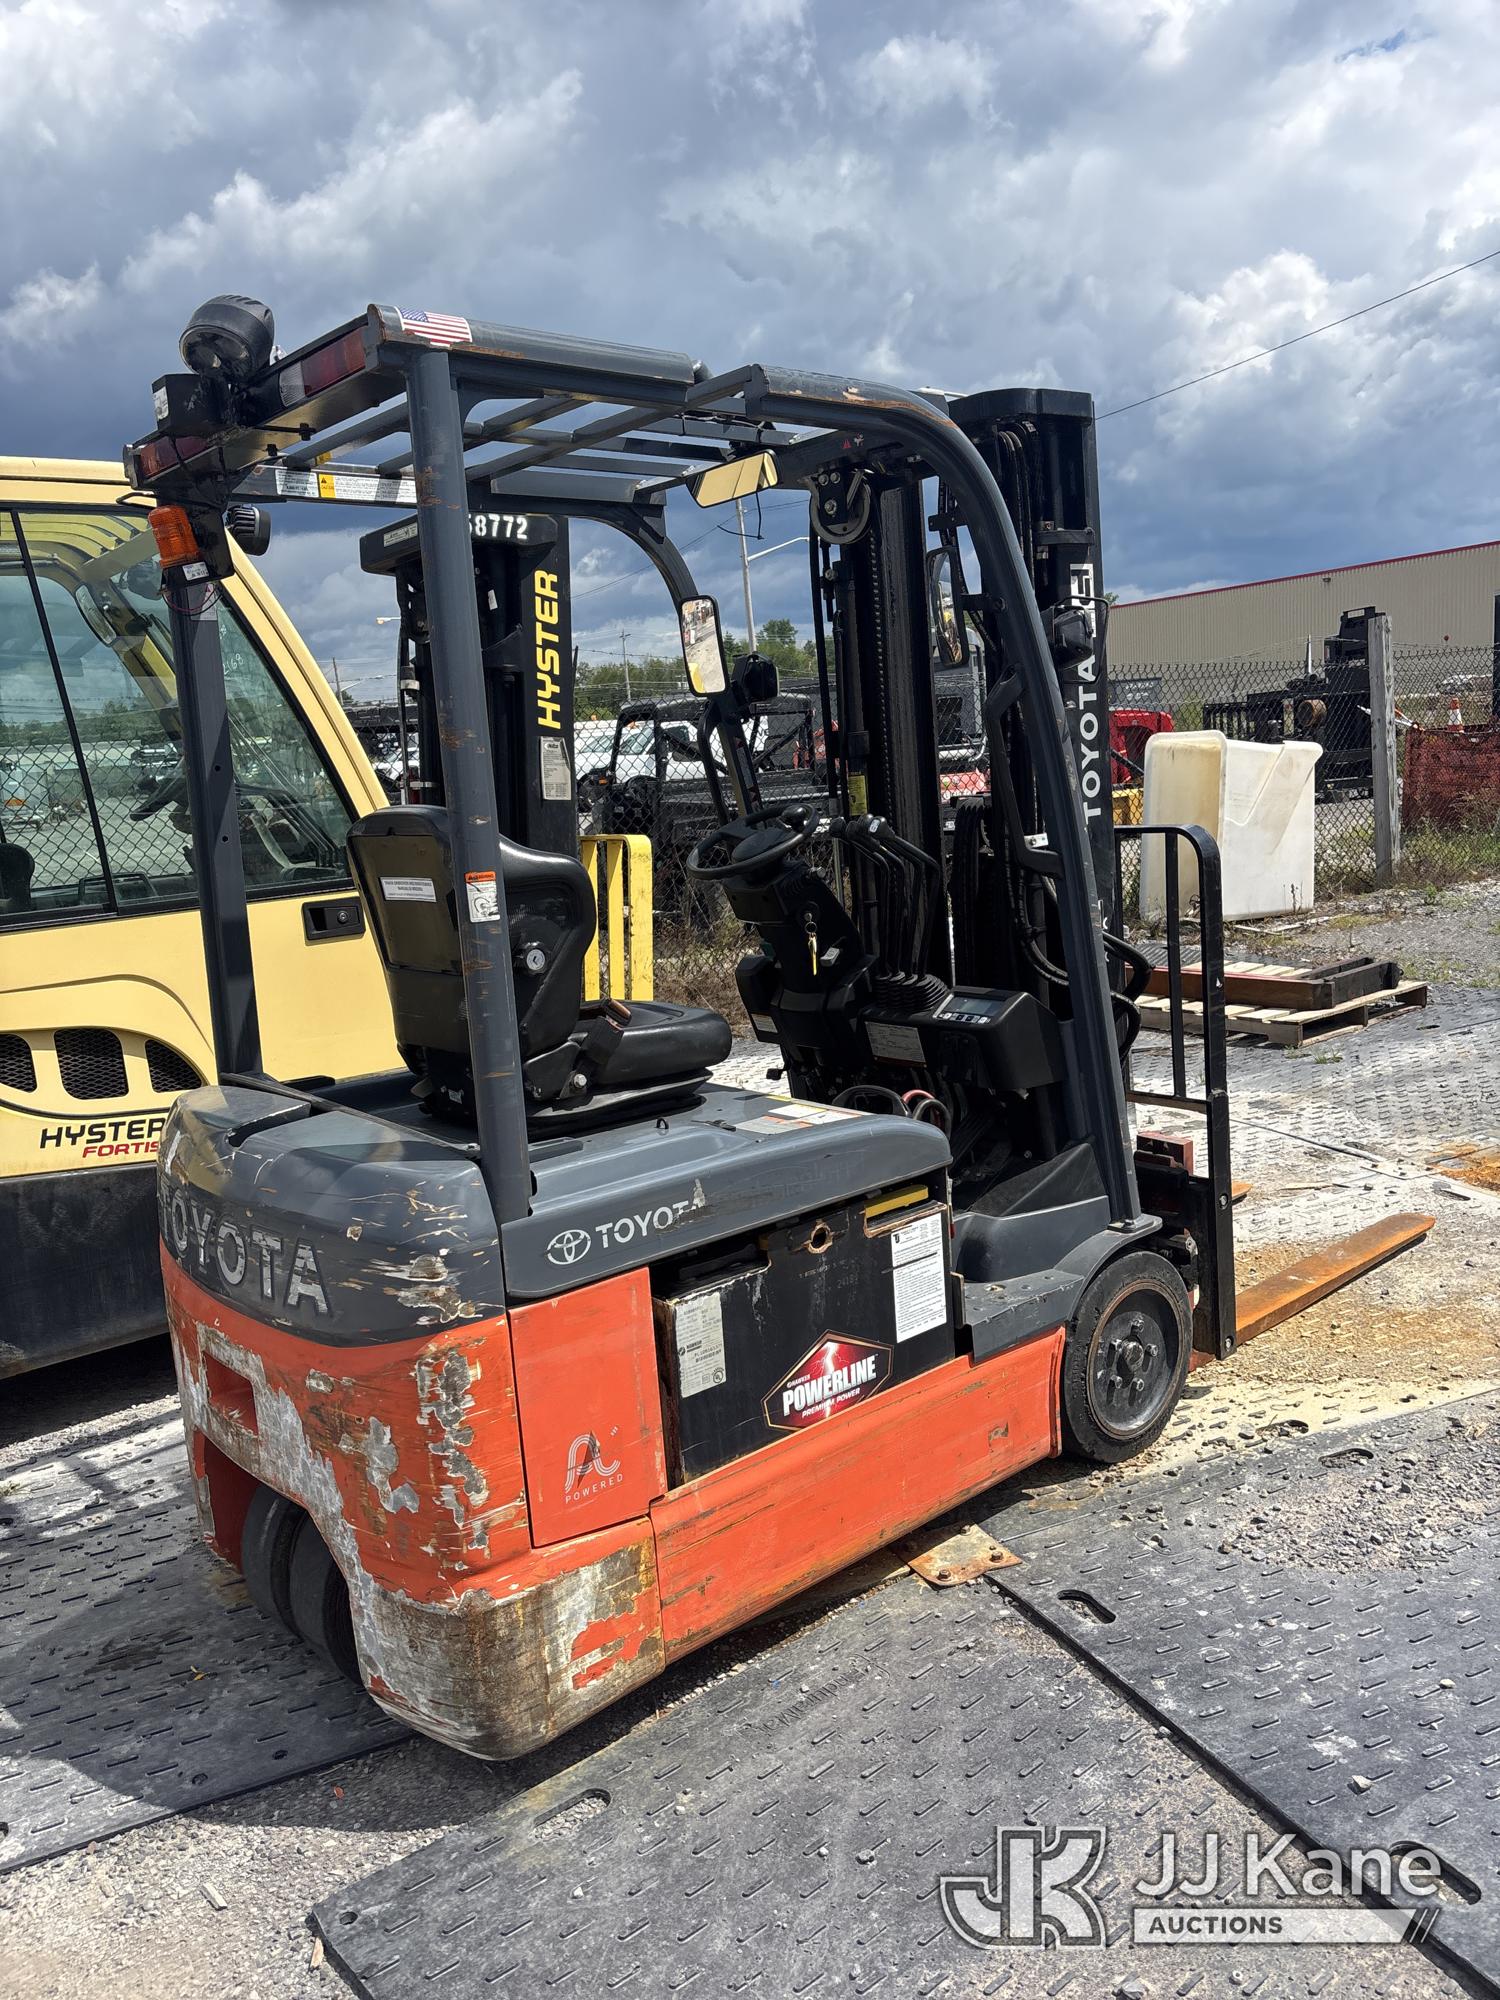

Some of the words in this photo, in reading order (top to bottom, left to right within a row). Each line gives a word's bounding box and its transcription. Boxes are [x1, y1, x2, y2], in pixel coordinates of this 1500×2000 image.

[534, 569, 562, 730] HYSTER
[1077, 654, 1102, 832] TOYOTA
[782, 1355, 877, 1417] POWERLINE
[836, 1388, 861, 1404] POWER
[565, 1473, 624, 1505] POWERED
